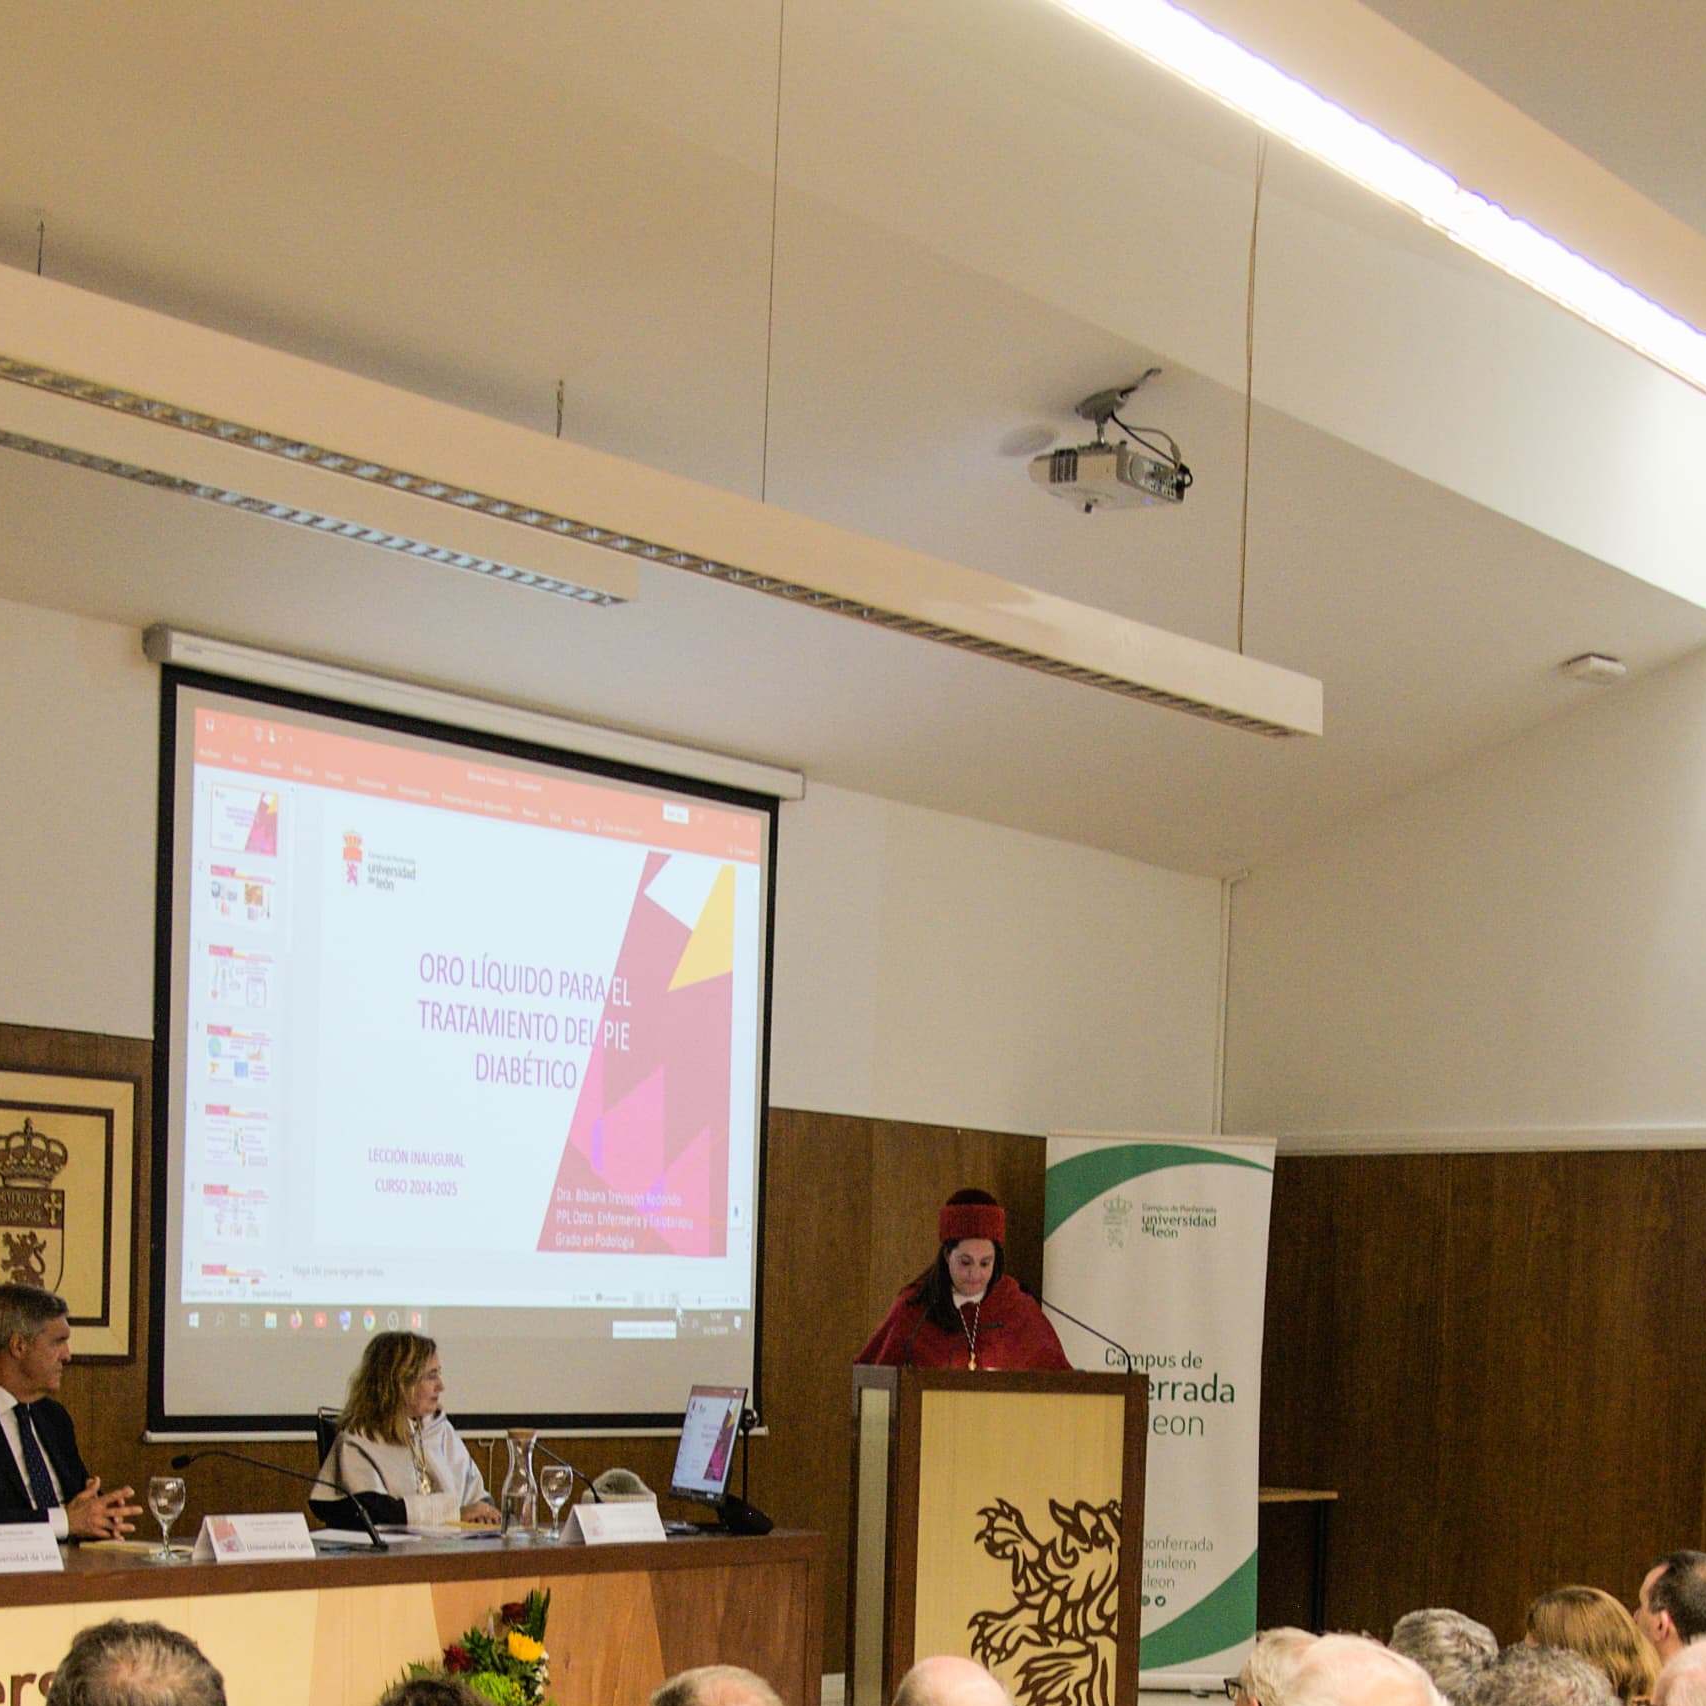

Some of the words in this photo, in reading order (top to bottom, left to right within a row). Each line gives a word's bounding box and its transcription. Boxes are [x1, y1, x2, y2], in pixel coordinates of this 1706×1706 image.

[420, 953, 464, 986] ORO
[472, 952, 553, 997] LÍQUIDO
[560, 970, 606, 1003] PARA
[613, 977, 632, 1007] EL
[418, 999, 558, 1043] TRATAMIENTO
[565, 1016, 596, 1047] DEL
[604, 1020, 630, 1051] PIE
[476, 1050, 577, 1090] DIABÉTICO
[368, 1145, 408, 1164] LECCIÓN
[410, 1149, 466, 1168] INAUGURAL
[375, 1177, 407, 1194] CURSO
[410, 1179, 458, 1197] 2024-2025
[1142, 1215, 1217, 1228] universidad
[555, 1232, 581, 1247] Grado
[583, 1236, 594, 1247] en
[1105, 1347, 1177, 1371] Campus
[1181, 1350, 1203, 1369] de
